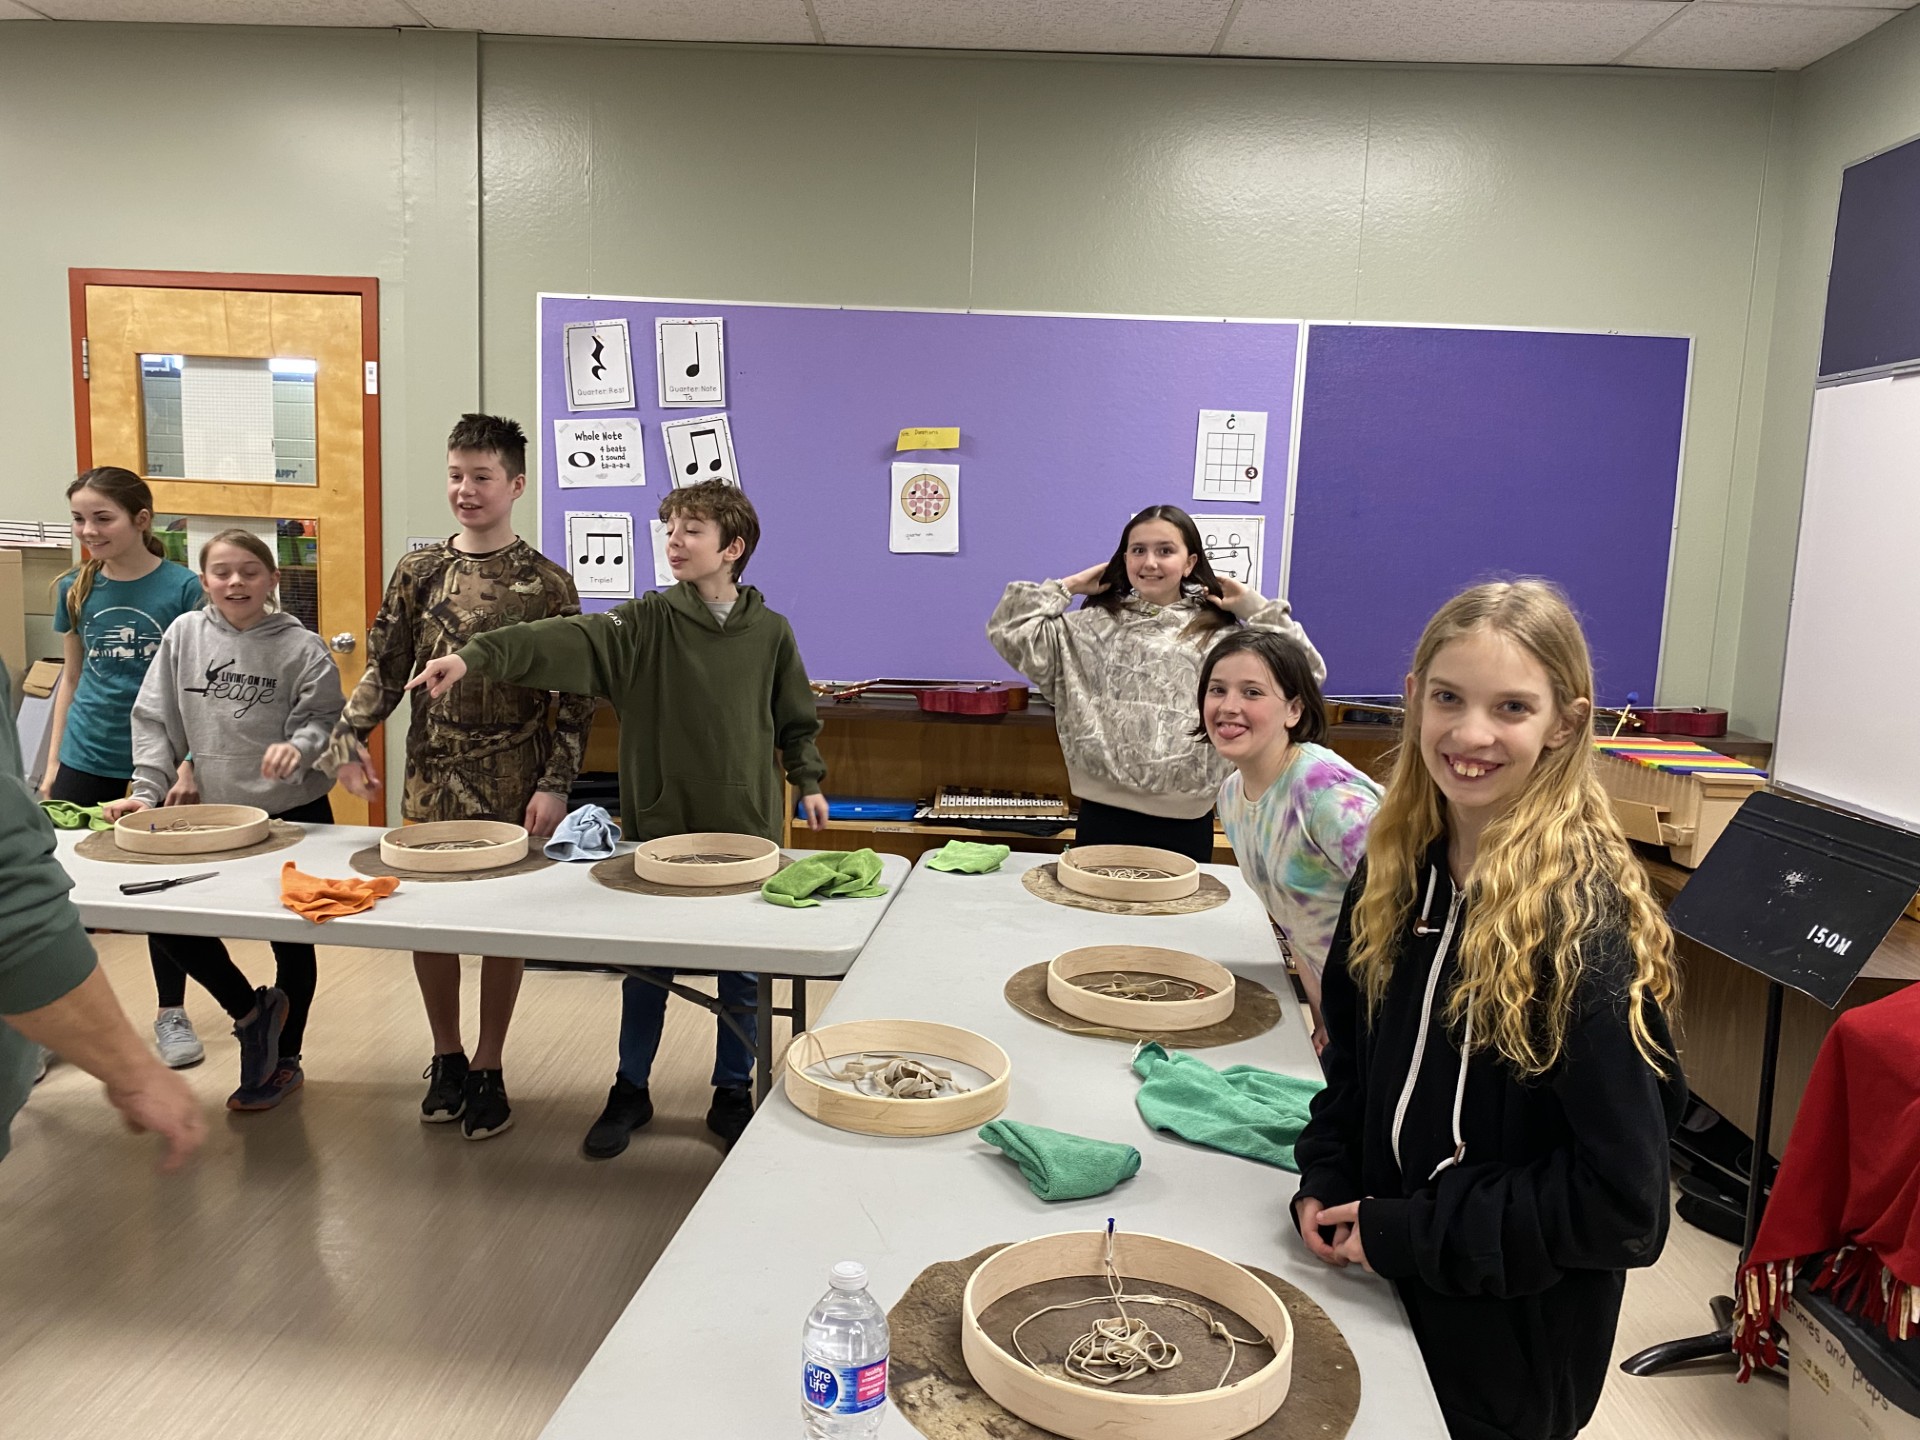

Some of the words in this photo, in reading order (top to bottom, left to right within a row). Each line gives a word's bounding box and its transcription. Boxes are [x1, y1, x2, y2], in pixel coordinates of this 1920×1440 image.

[577, 388, 607, 396] Quarter
[608, 387, 625, 395] Rest
[669, 385, 699, 393] Quarter
[574, 430, 600, 441] Whole
[602, 431, 623, 441] Note
[606, 444, 627, 453] beats
[606, 453, 626, 461] sound
[589, 576, 613, 585] Triplet
[247, 675, 261, 686] ON
[262, 677, 278, 689] THE
[213, 679, 276, 719] edge
[1824, 1339, 1847, 1368] and
[807, 1362, 832, 1384] Pure
[809, 1375, 828, 1394] Life
